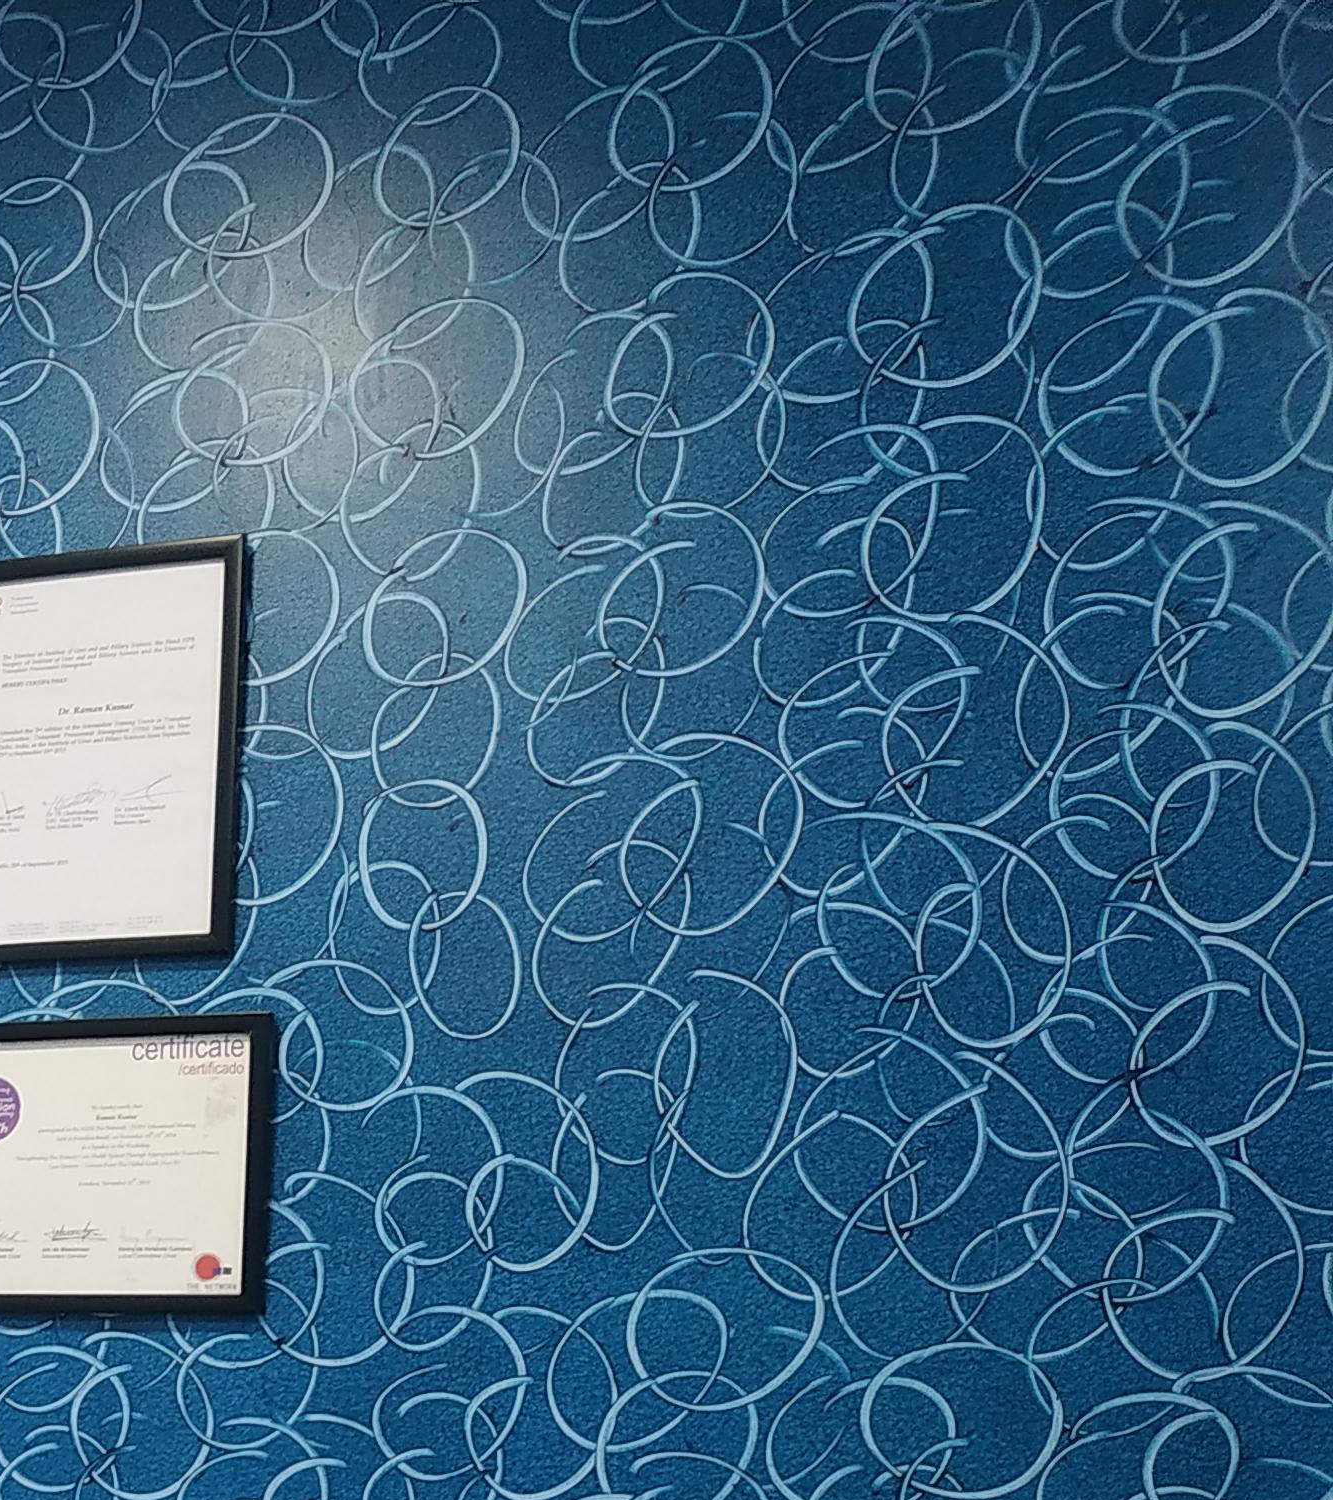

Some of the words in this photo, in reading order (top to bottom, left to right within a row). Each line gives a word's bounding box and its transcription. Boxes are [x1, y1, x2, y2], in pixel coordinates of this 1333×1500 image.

[58, 707, 71, 716] Dr.
[74, 705, 103, 715] Raman
[105, 703, 134, 712] Kumar
[132, 1036, 244, 1061] certificate
[178, 1061, 245, 1077] /certificado
